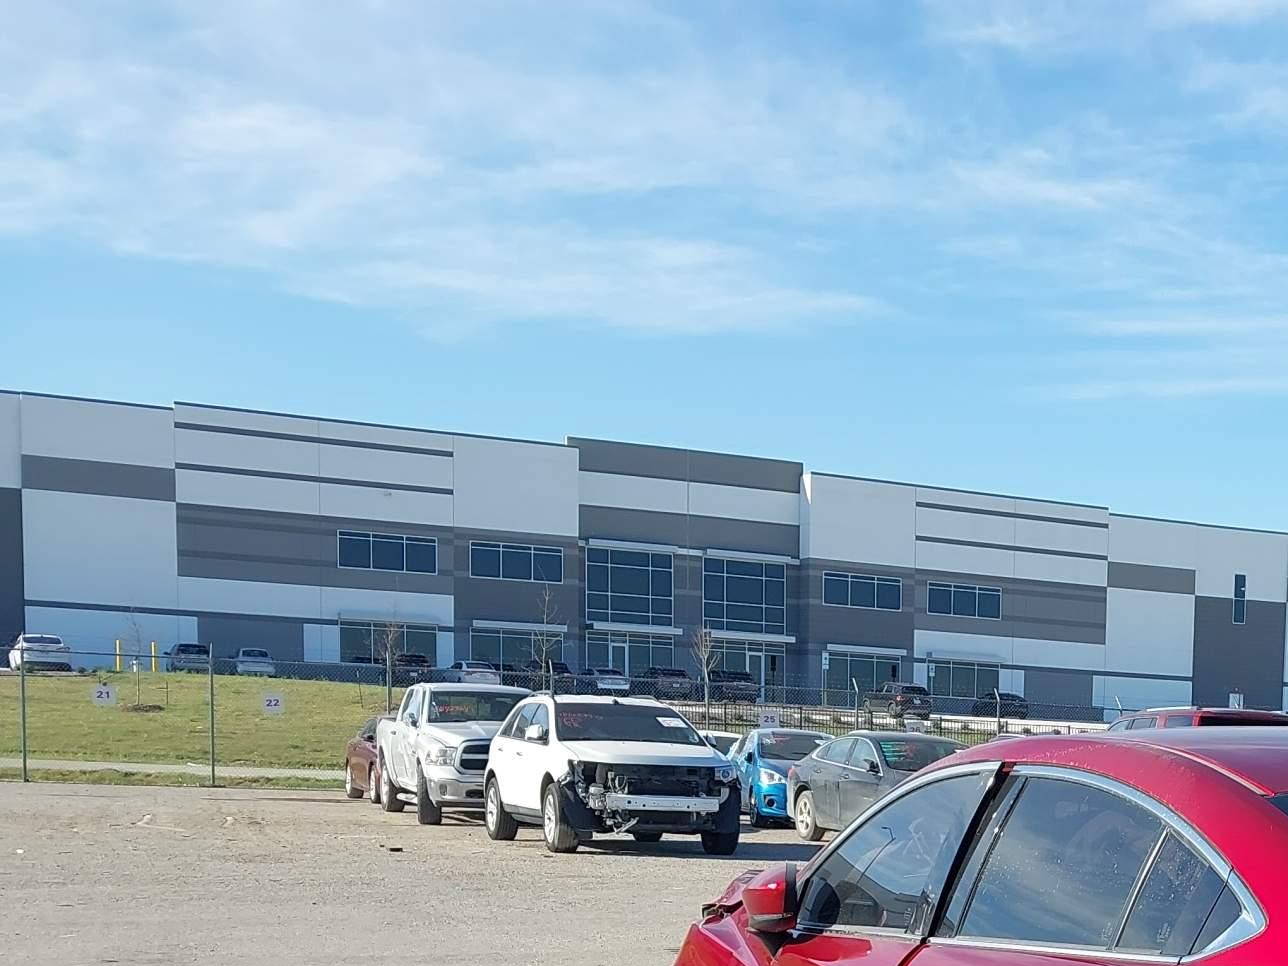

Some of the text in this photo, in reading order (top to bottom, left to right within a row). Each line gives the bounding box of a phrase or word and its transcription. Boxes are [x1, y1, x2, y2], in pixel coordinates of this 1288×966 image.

[96, 690, 111, 699] 21
[265, 699, 280, 707] 22
[763, 715, 775, 723] 25
